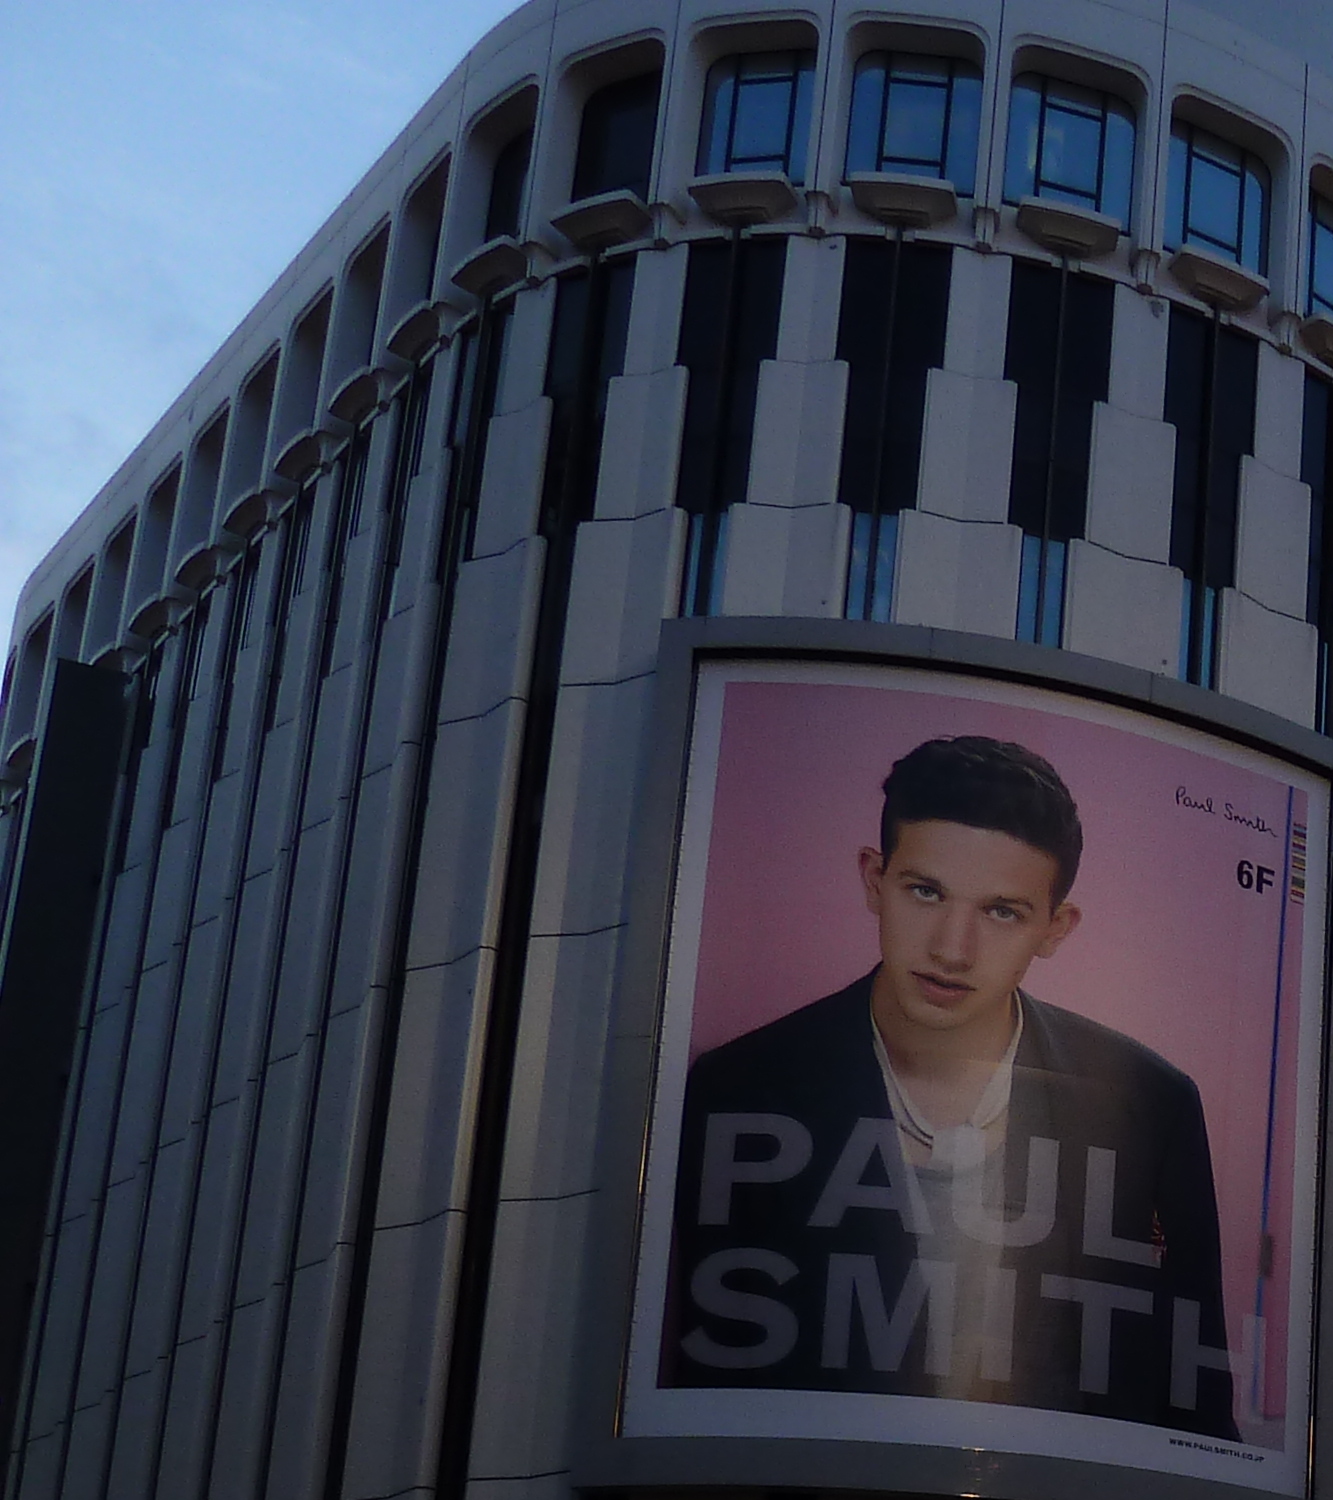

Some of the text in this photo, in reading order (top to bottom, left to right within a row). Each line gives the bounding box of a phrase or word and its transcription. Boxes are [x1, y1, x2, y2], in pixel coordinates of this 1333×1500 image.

[1175, 785, 1278, 838] Paul Smith
[1236, 859, 1275, 895] 6F
[697, 1112, 1163, 1270] PAUL
[679, 1247, 1269, 1425] SMITH
